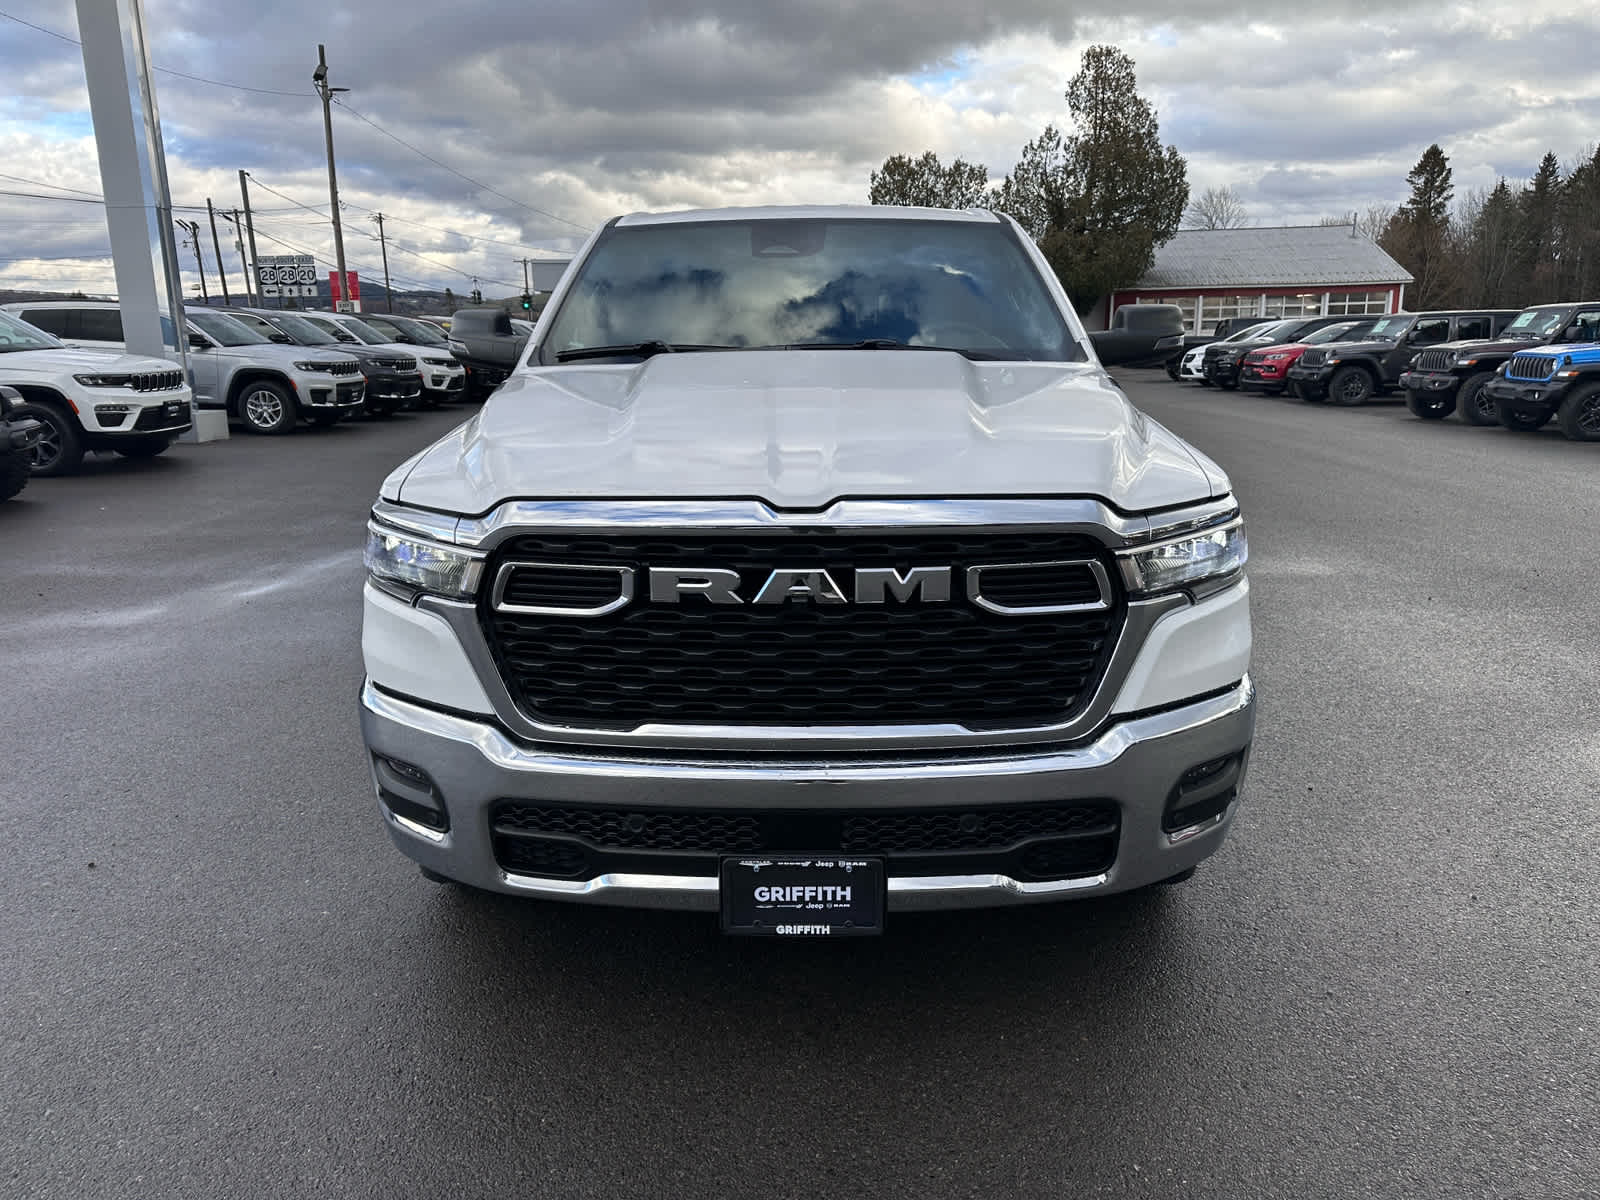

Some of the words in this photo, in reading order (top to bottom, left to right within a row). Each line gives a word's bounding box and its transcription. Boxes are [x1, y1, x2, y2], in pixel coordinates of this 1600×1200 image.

[261, 270, 276, 281] 28
[280, 270, 295, 281] 28
[300, 270, 315, 281] 20
[649, 566, 952, 605] RAM
[815, 860, 834, 868] Jeep
[753, 886, 852, 902] GRIFFITH
[775, 924, 831, 935] GRIFFITH
